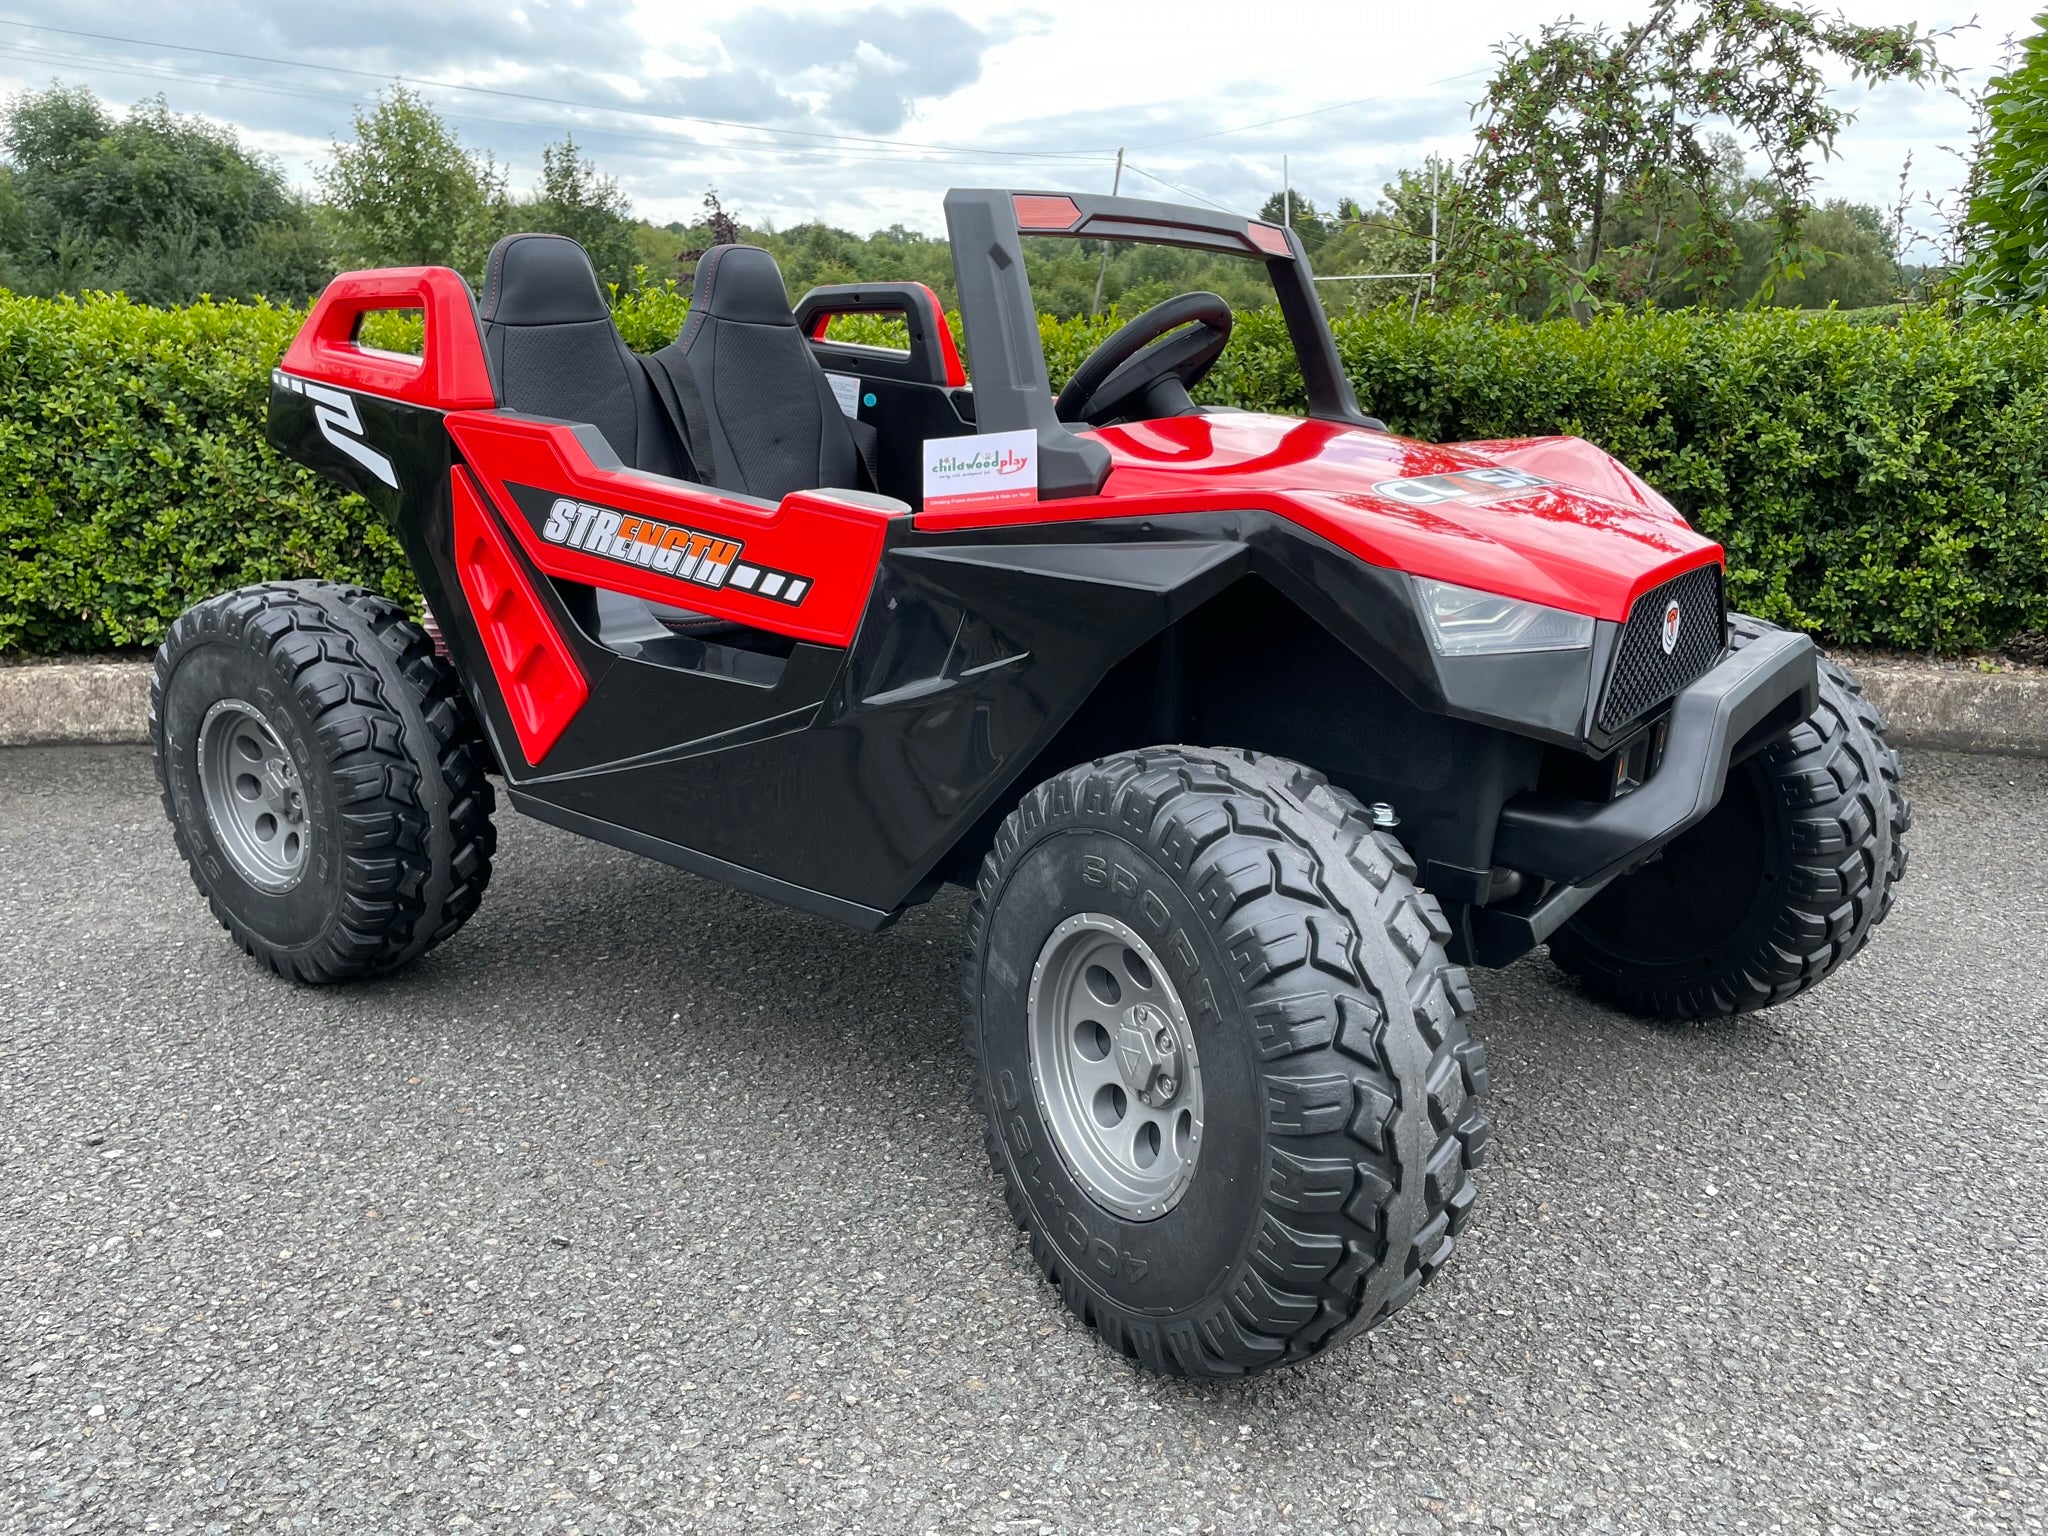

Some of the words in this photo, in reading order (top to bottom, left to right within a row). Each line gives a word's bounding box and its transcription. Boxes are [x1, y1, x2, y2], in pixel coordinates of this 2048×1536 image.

[932, 449, 1028, 475] childwoodplay
[543, 499, 742, 587] STRENGTH
[1081, 853, 1224, 1024] SPORT
